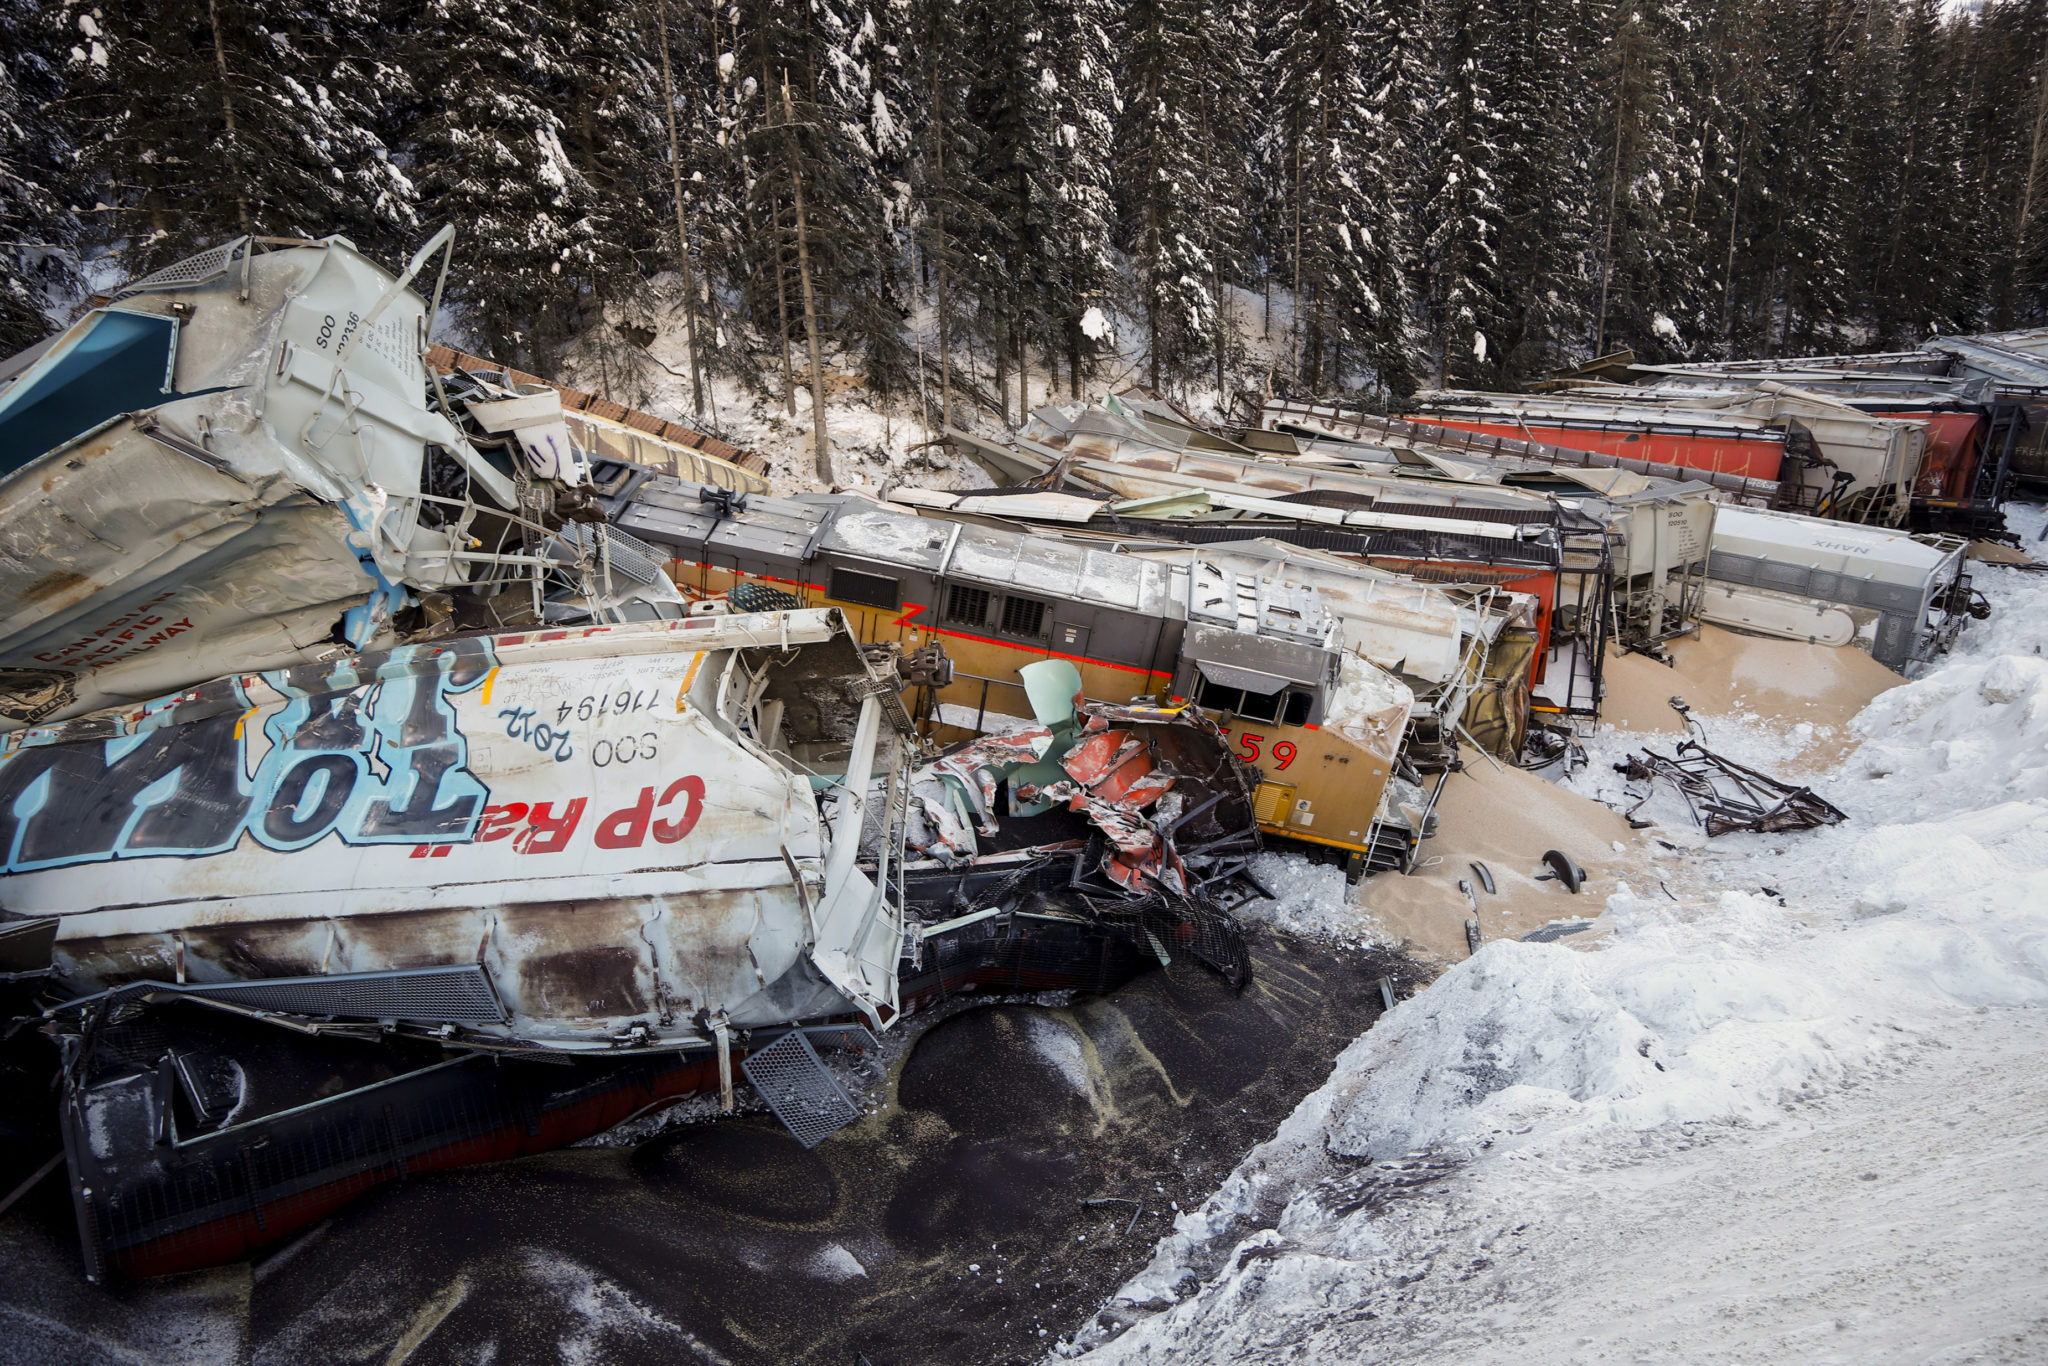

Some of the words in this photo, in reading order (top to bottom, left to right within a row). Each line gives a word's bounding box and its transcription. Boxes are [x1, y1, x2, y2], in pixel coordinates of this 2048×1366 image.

[316, 314, 336, 349] SOO
[1811, 540, 1870, 555] NAHX
[33, 592, 176, 663] CANADIAN
[60, 615, 163, 667] PACIFIC
[88, 617, 195, 669] RAILWAY
[557, 688, 660, 727] 116194
[498, 705, 573, 763] 2012
[592, 732, 658, 767] SOO
[1218, 727, 1298, 771] 59
[409, 796, 588, 858] Ra
[594, 775, 706, 850] CP
